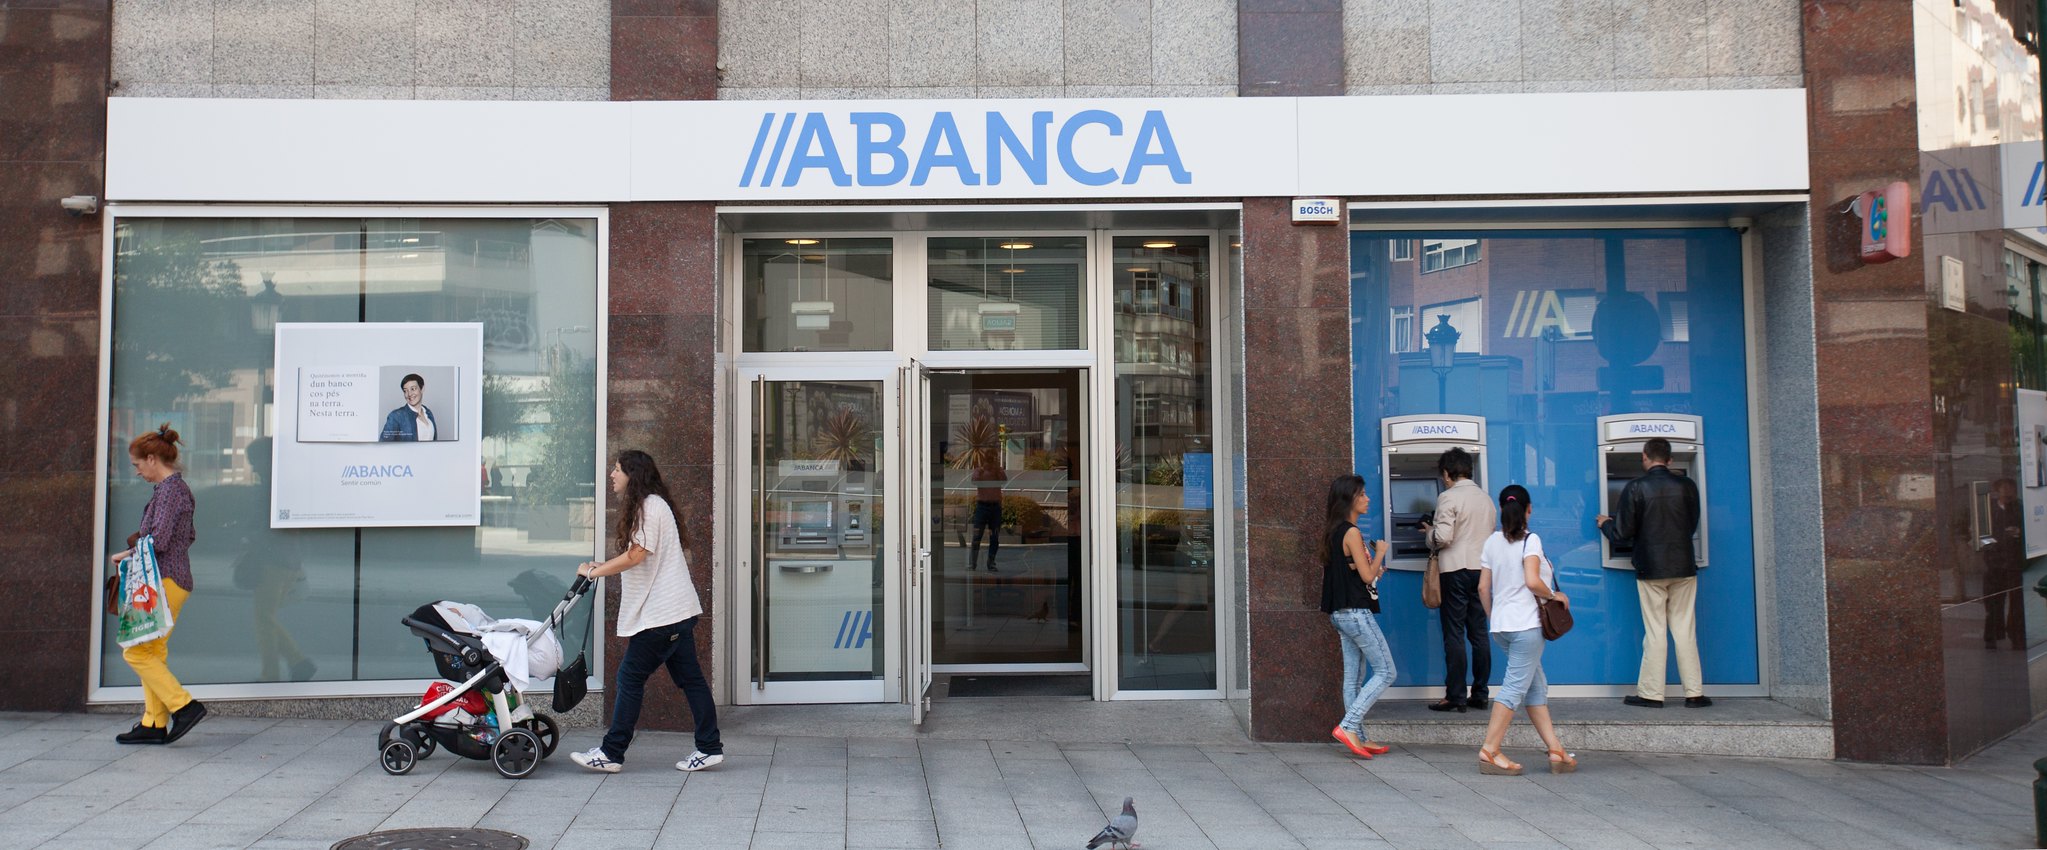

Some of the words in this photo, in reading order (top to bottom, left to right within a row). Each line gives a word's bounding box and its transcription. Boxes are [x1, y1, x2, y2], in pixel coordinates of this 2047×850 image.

[1300, 206, 1333, 215] BOSCH
[309, 380, 326, 388] dun
[328, 380, 353, 388] banco
[326, 389, 340, 399] pés
[321, 400, 344, 408] terra.
[309, 409, 333, 417] Nesta
[335, 409, 358, 417] terra.
[340, 479, 359, 487] Sentir
[360, 479, 382, 487] común
[131, 621, 155, 634] TIGER
